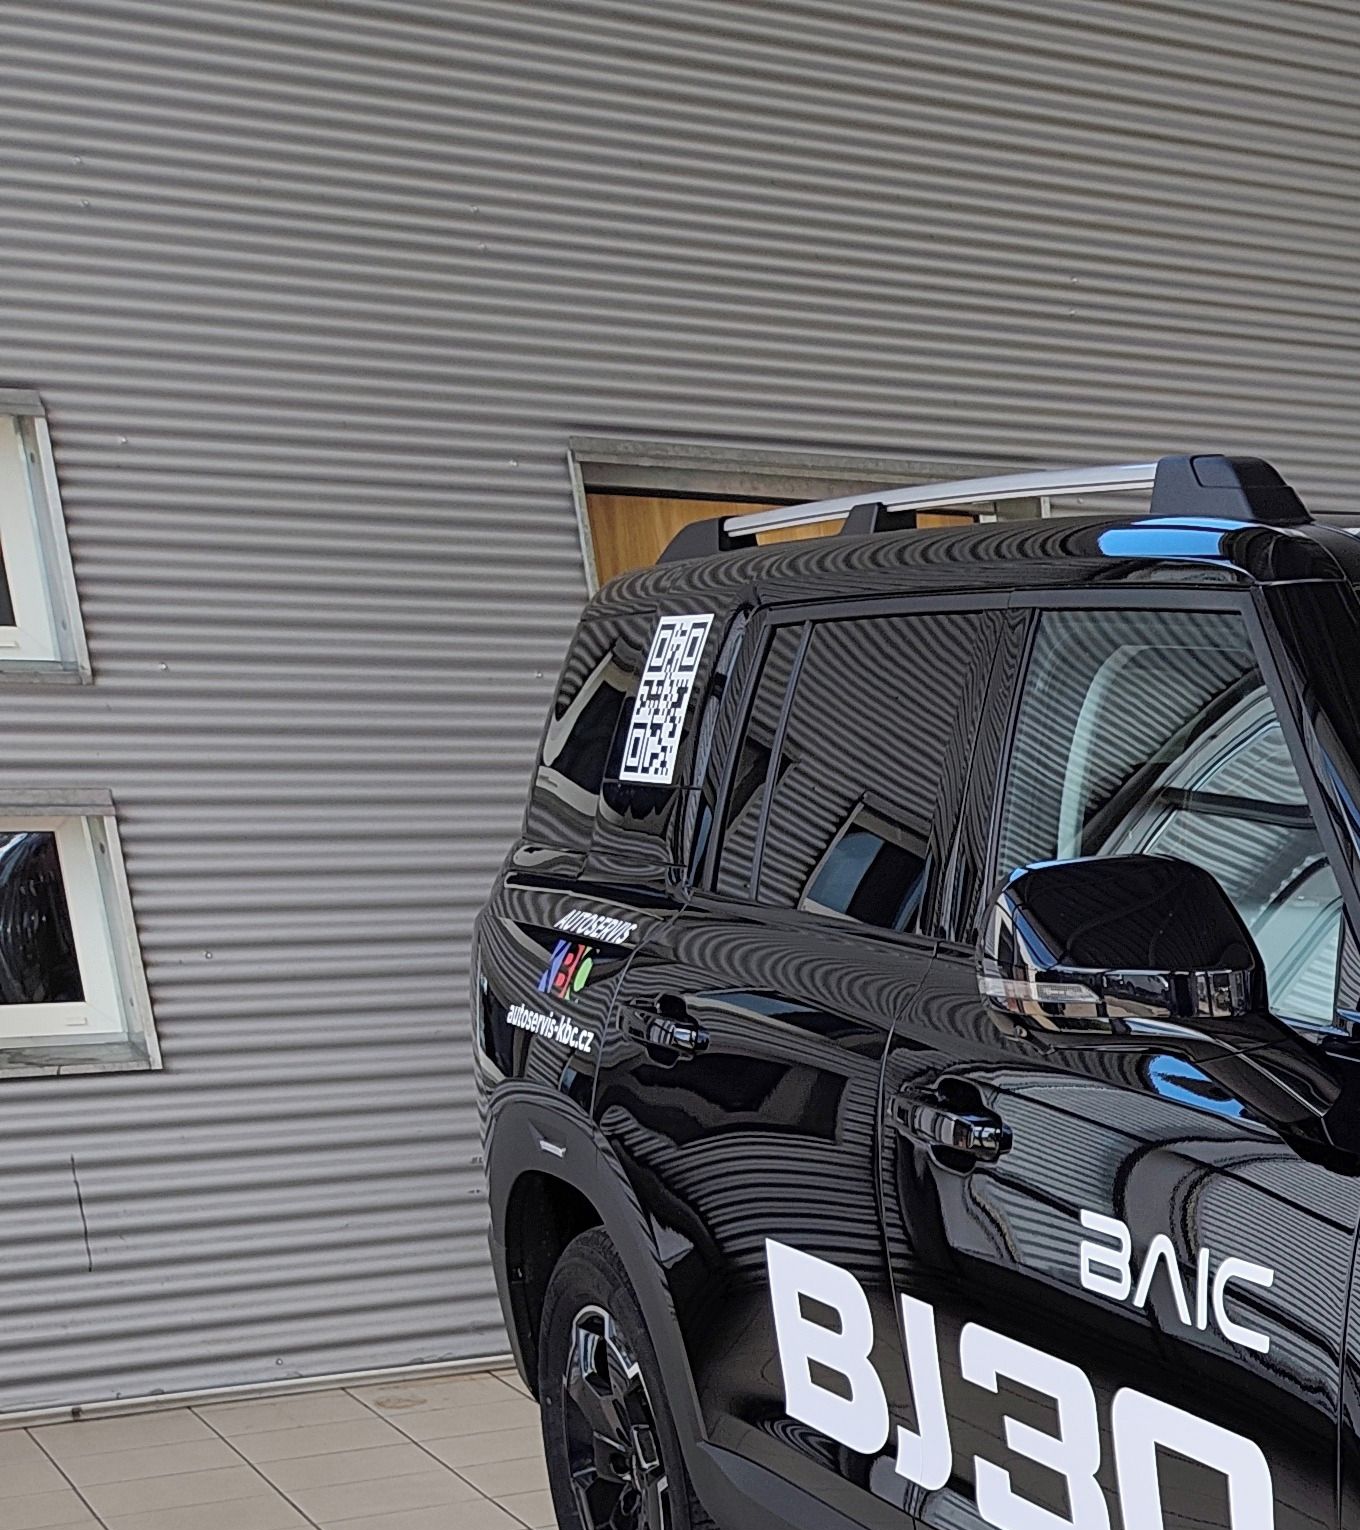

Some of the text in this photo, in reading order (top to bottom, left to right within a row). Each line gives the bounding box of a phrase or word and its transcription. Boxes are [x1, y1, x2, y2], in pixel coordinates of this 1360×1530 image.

[553, 909, 638, 944] AUTOSERVIS
[506, 1003, 595, 1053] autoservis-kbc.cz
[1080, 1208, 1275, 1354] BAIC
